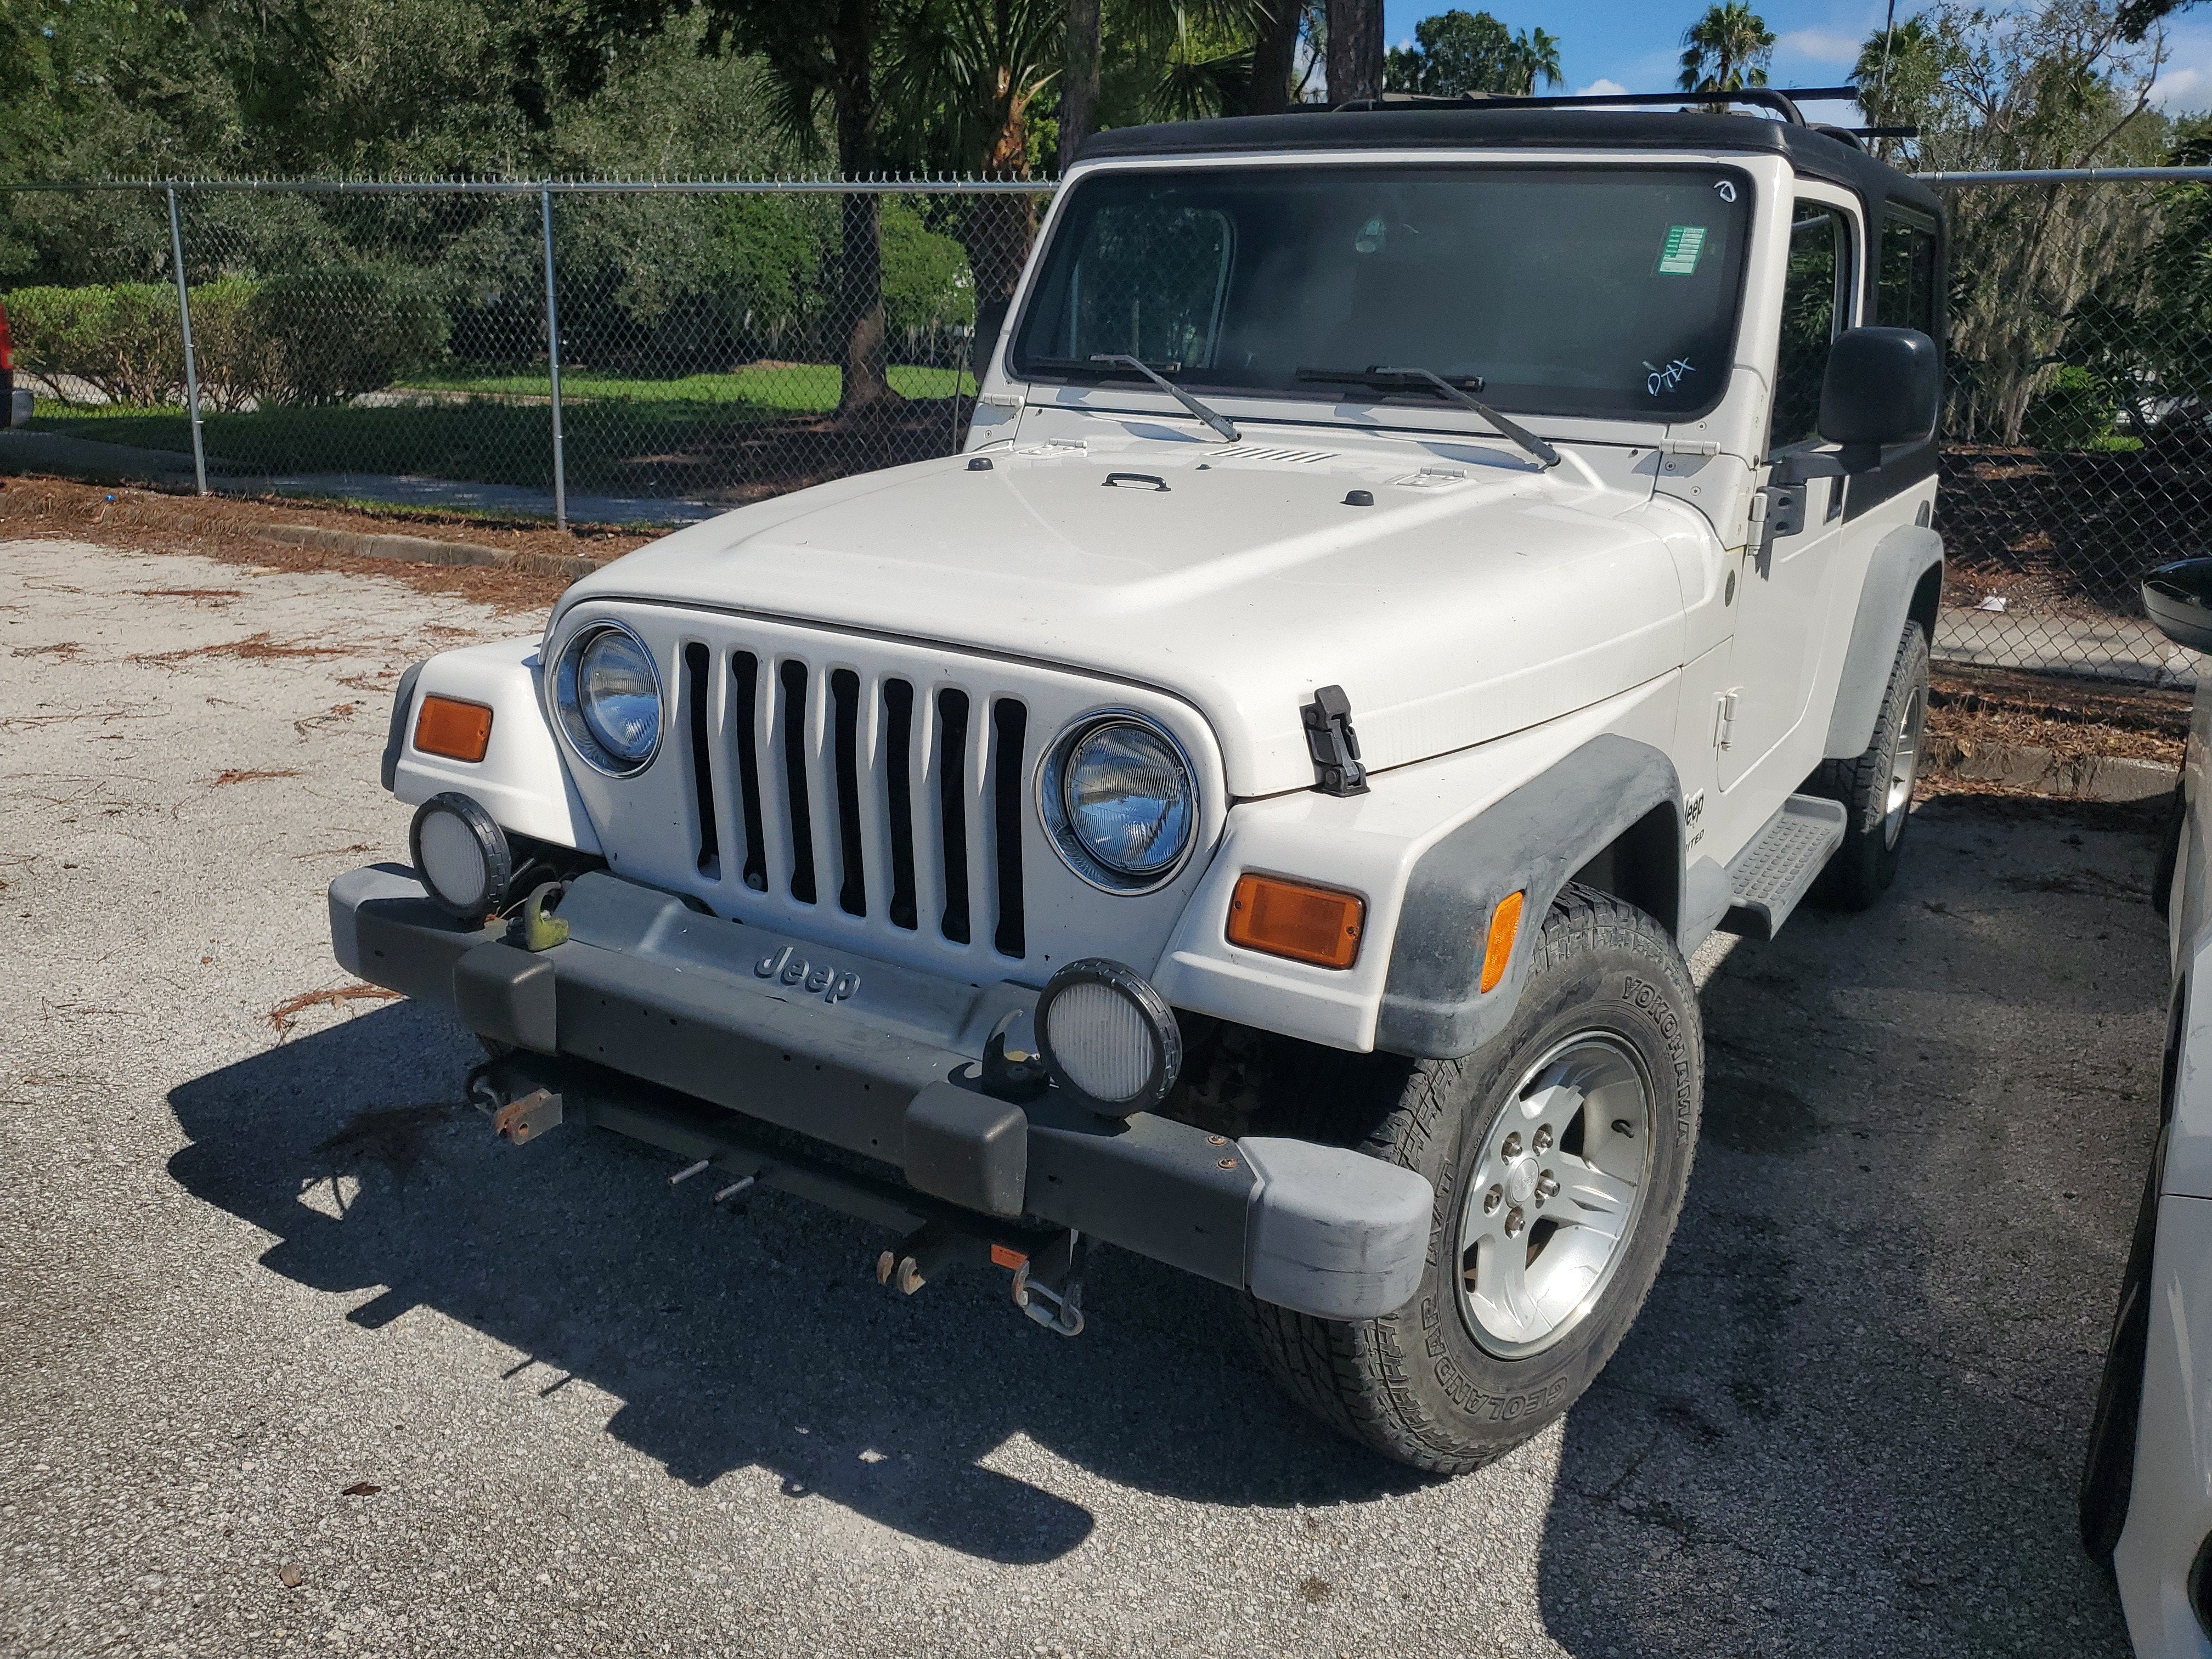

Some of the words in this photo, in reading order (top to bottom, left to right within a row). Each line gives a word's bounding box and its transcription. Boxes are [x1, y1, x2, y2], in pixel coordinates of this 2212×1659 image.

[753, 946, 860, 1004] Jeep
[1622, 975, 1691, 1148] YOKOHAMA
[1420, 1295, 1567, 1421] GEOLANDAR
